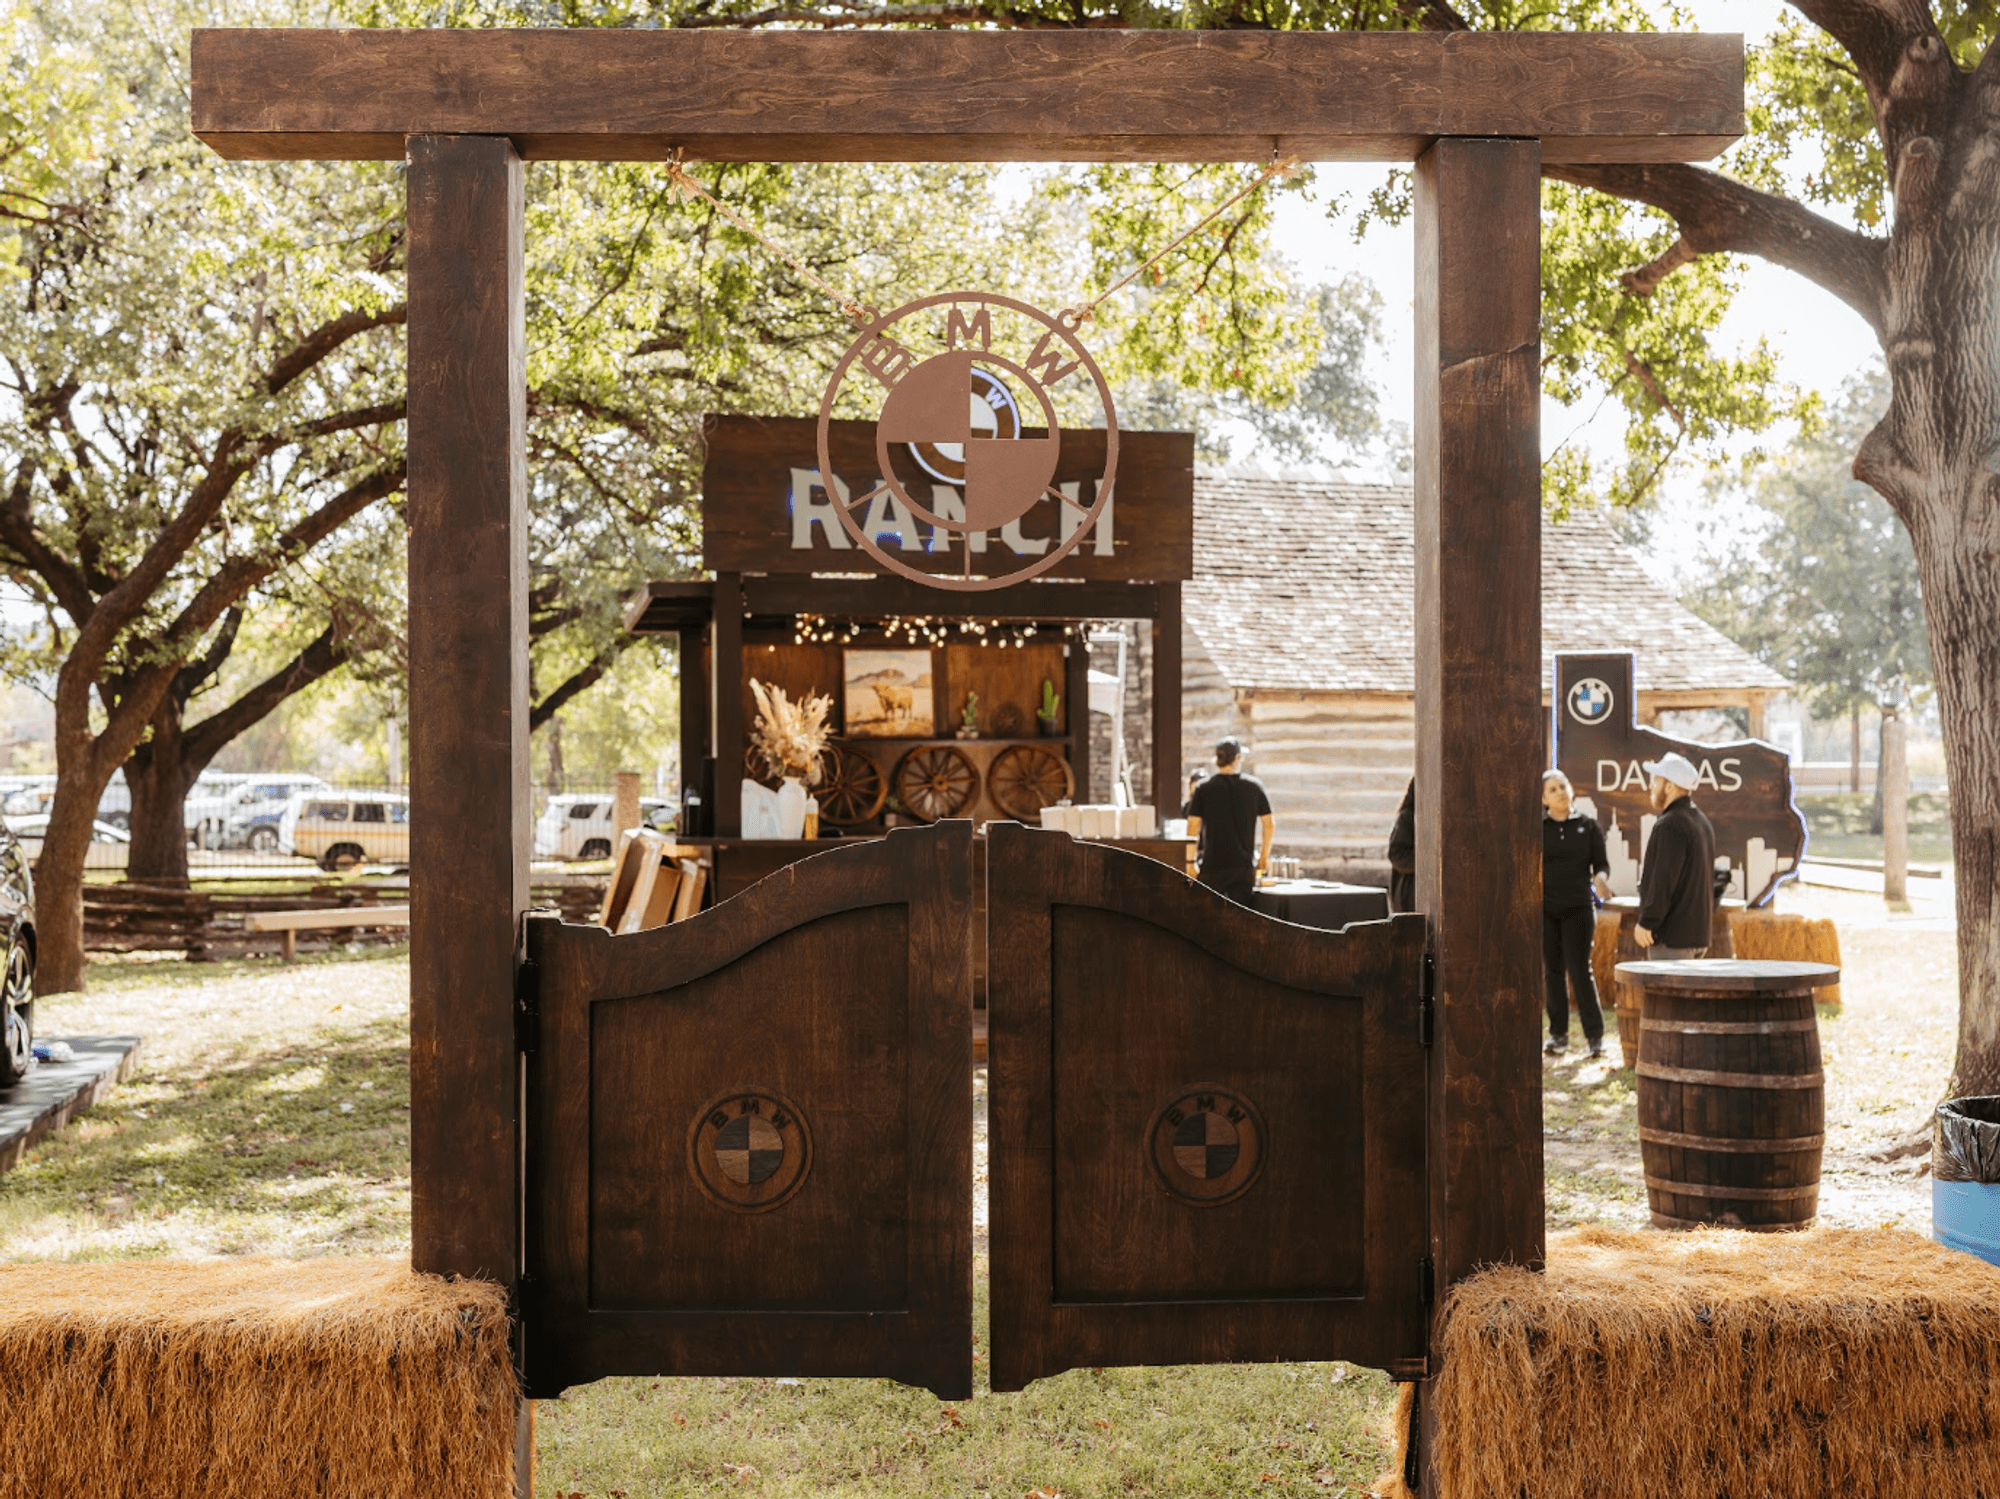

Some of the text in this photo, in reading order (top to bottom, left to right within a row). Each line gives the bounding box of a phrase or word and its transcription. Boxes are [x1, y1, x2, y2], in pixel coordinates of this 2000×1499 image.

[861, 309, 1079, 388] BMW
[1597, 758, 1742, 791] DAAS
[709, 1100, 792, 1130] BMW
[1166, 1096, 1246, 1127] BMW
